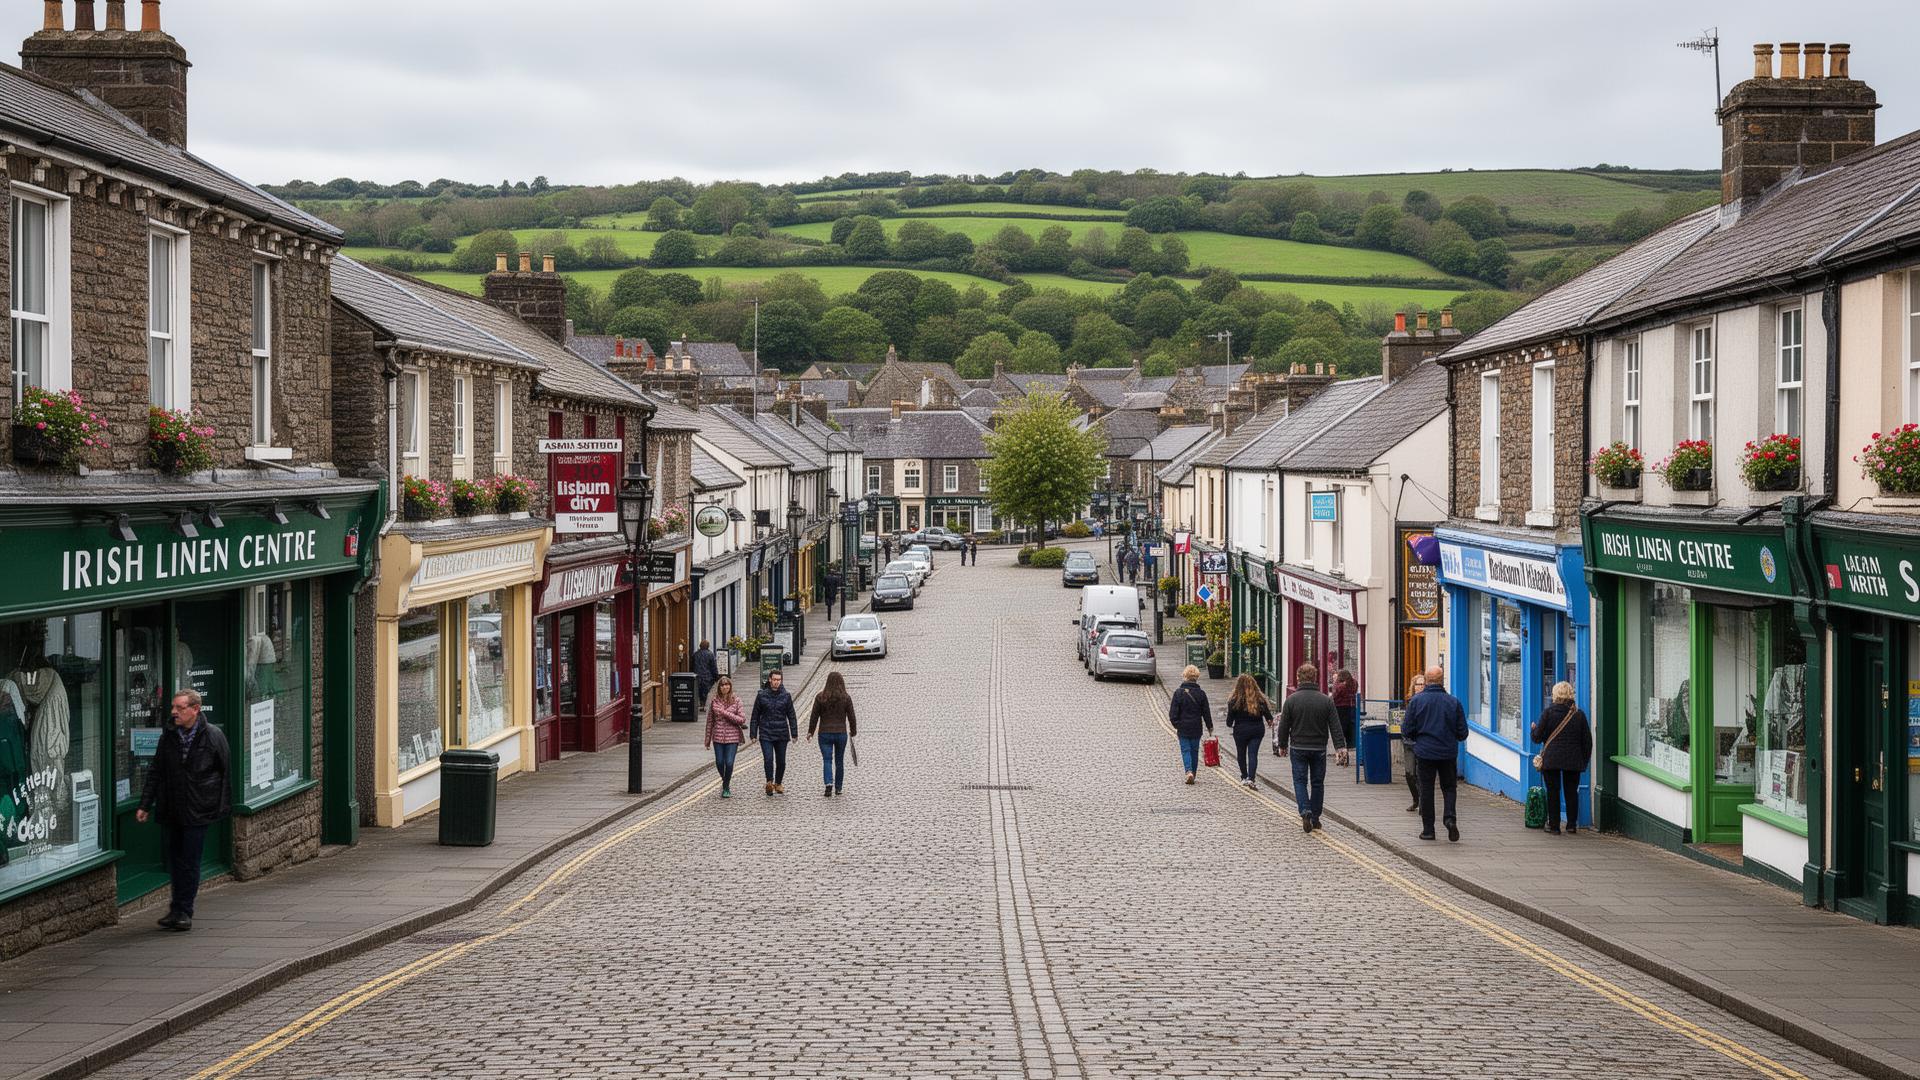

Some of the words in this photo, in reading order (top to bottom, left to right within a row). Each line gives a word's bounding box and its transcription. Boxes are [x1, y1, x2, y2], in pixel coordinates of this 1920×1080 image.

[62, 544, 143, 591] IRISH
[156, 537, 229, 579] LINEN
[238, 529, 316, 569] CENTRE
[1602, 532, 1632, 557] IRISH
[1635, 535, 1673, 563] LINEN
[1678, 540, 1735, 570] CENTRE
